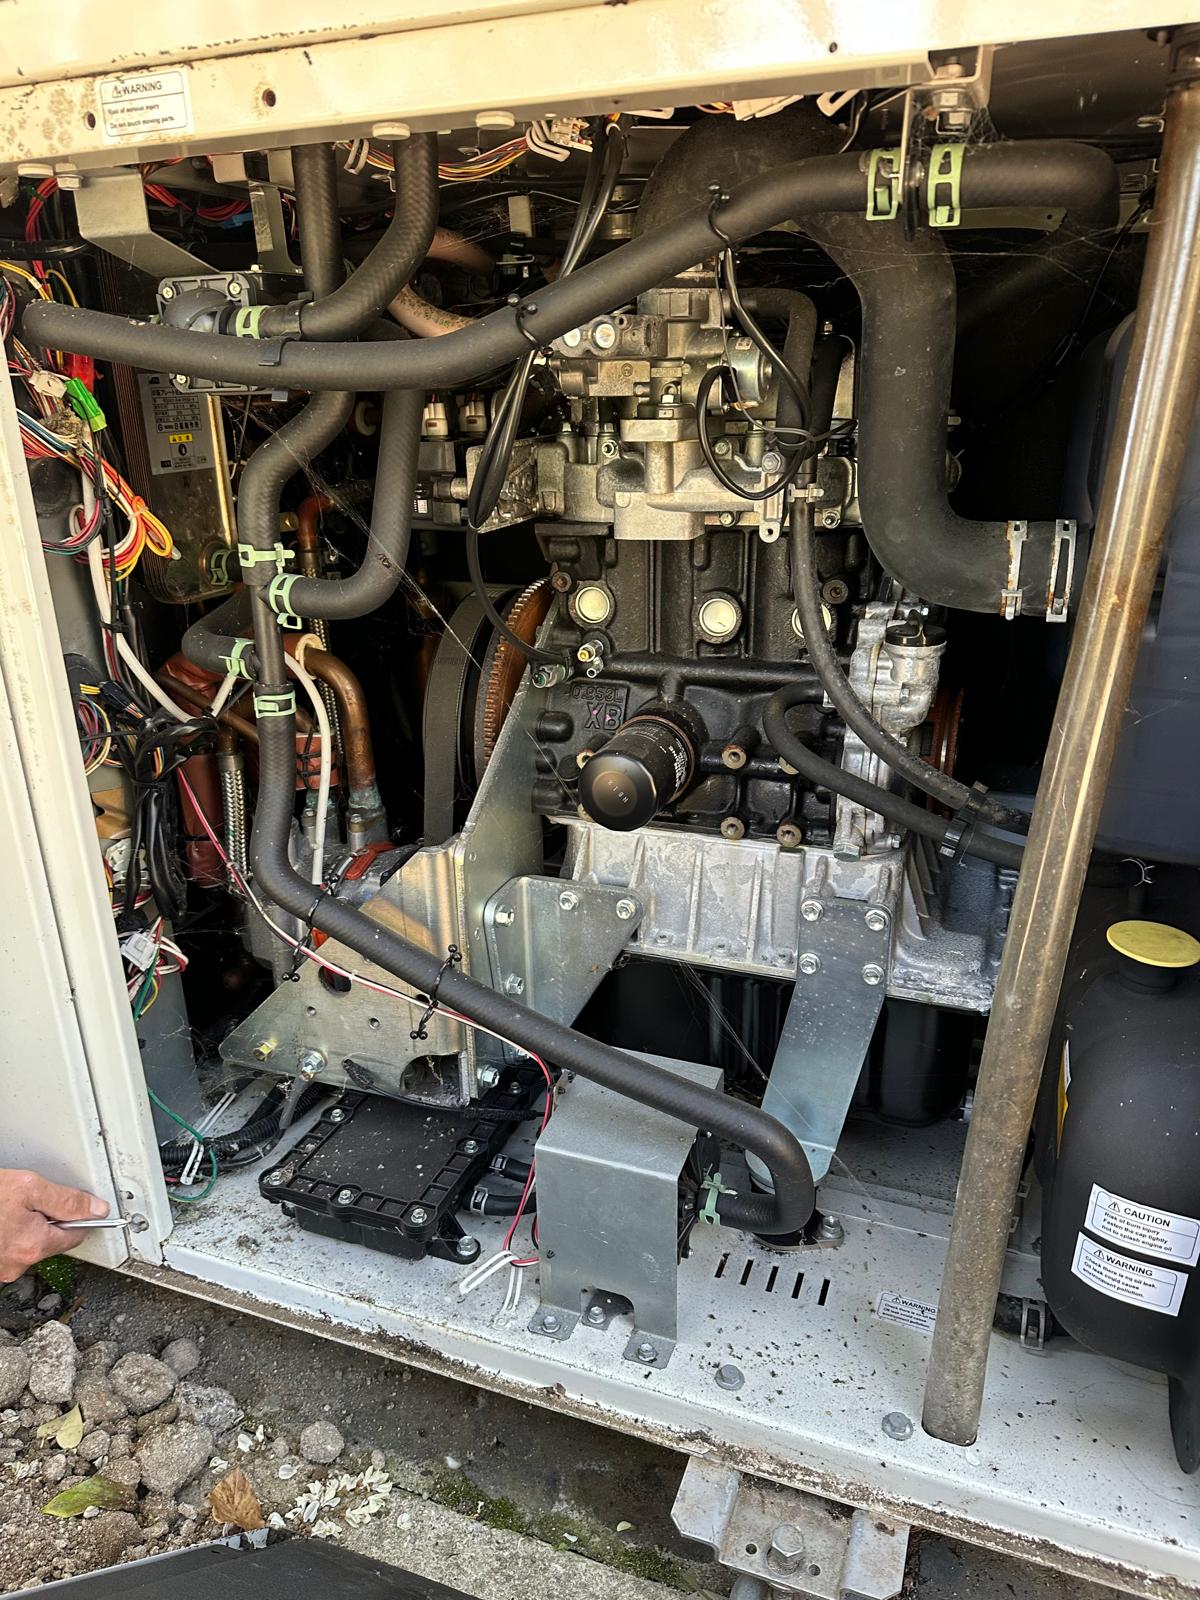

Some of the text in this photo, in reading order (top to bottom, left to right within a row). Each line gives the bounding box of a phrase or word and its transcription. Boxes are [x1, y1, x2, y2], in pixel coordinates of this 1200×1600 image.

[122, 81, 162, 94] WARNING
[584, 702, 623, 731] XB
[1104, 1212, 1118, 1221] Risk
[1126, 1220, 1141, 1230] burn
[1142, 1225, 1160, 1236] injury
[1123, 1207, 1171, 1228] CAUTION
[1101, 1224, 1112, 1233] not
[1120, 1232, 1141, 1244] splash
[1141, 1239, 1163, 1250] engine
[1103, 1218, 1168, 1245] Fasten the cap tightly
[1085, 1255, 1102, 1268] Check
[1102, 1265, 1118, 1275] there
[1106, 1254, 1153, 1277] WARNING
[1082, 1267, 1116, 1289] environment
[1092, 1265, 1104, 1276] leak
[1104, 1274, 1121, 1284] could
[1121, 1281, 1140, 1290] cause
